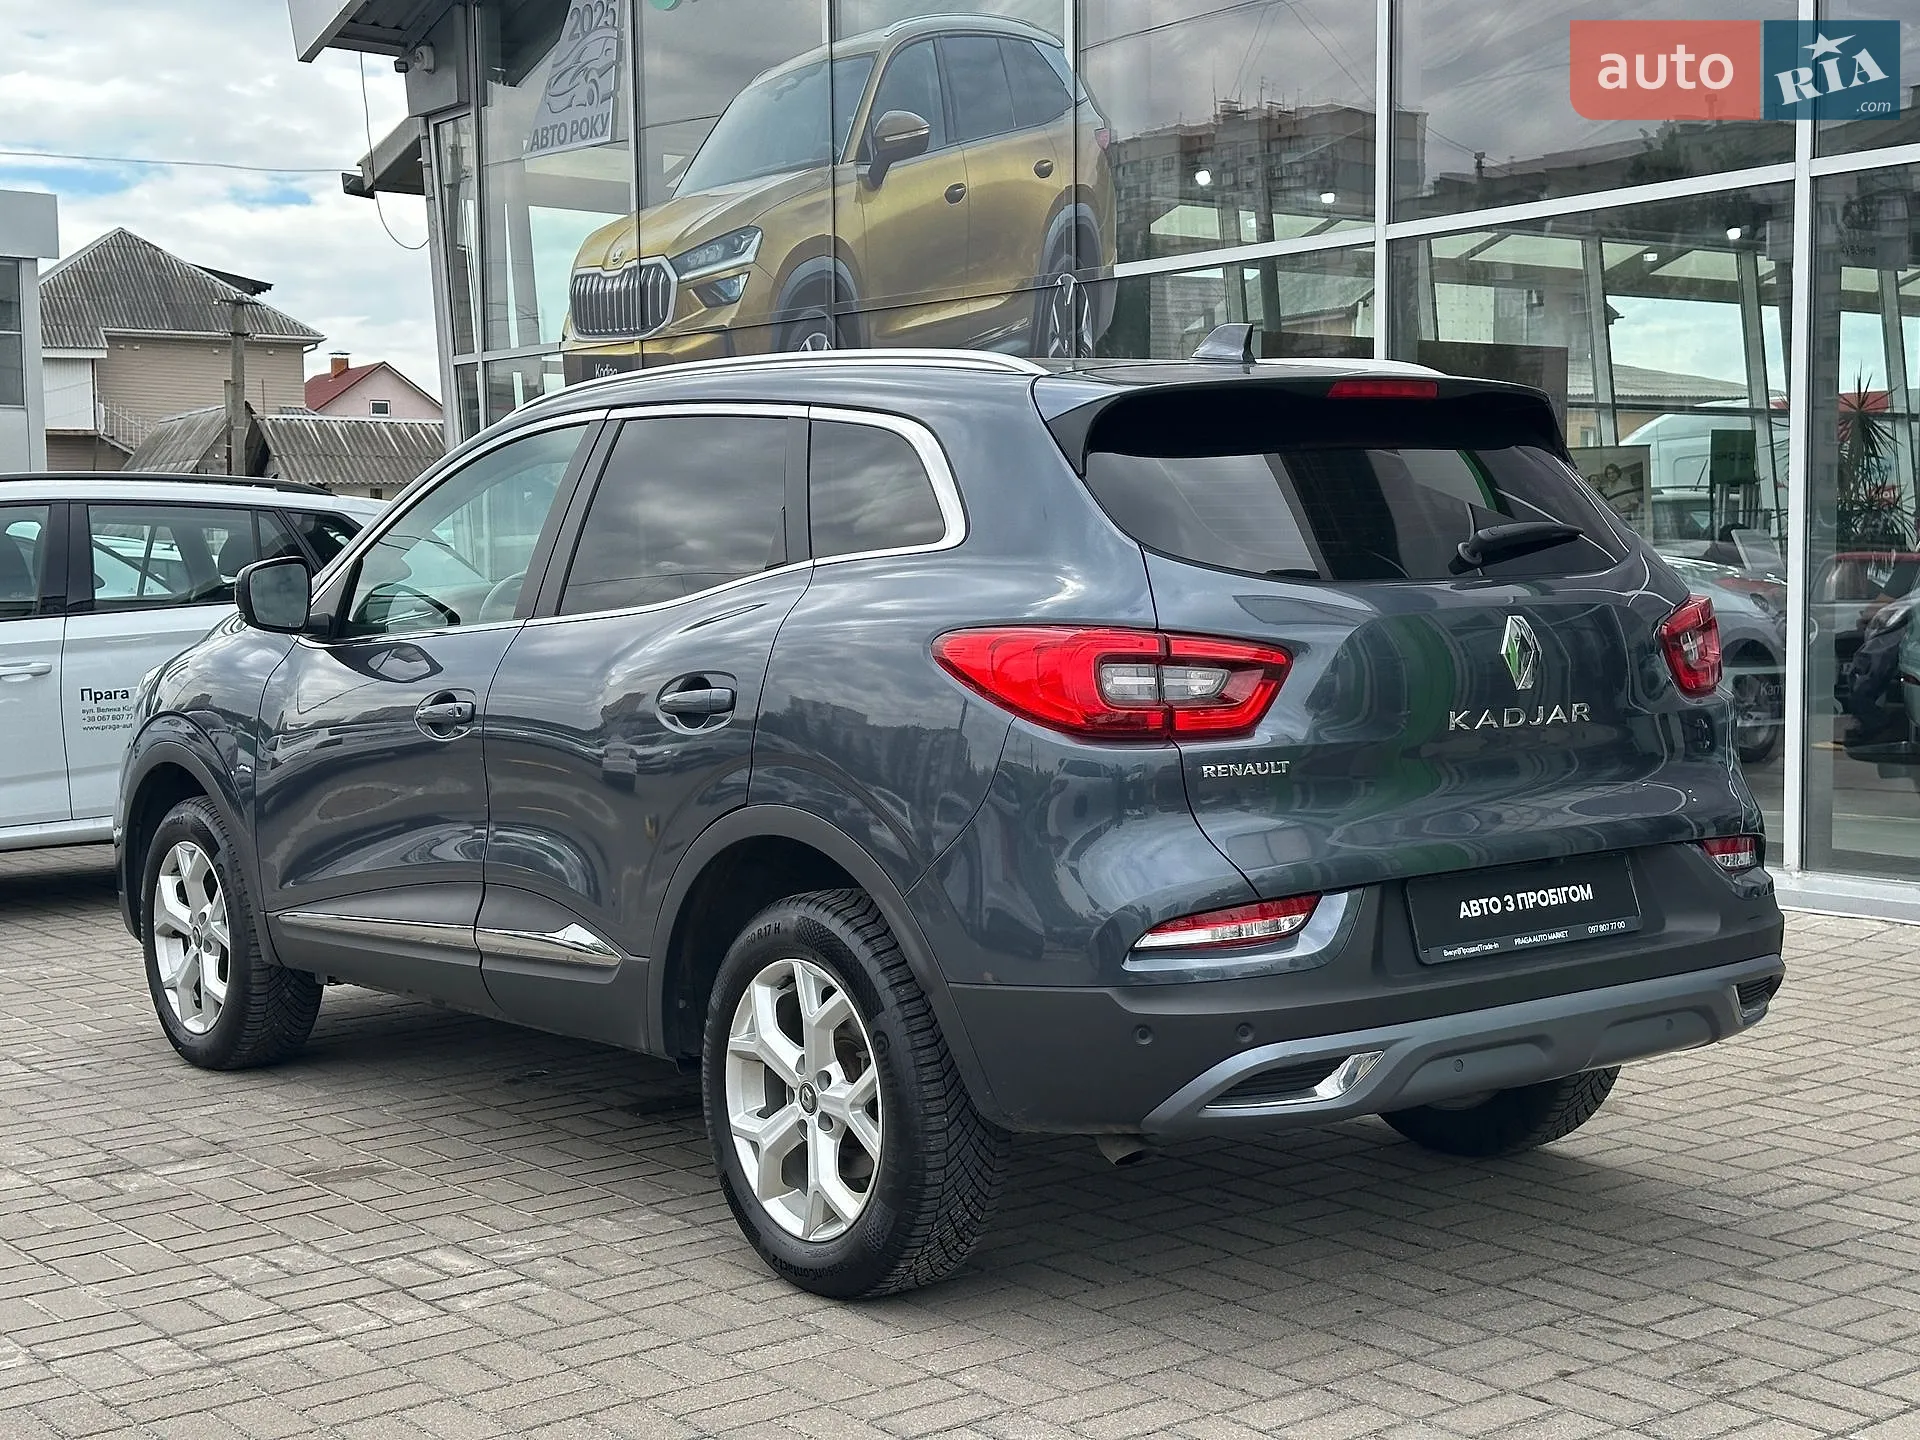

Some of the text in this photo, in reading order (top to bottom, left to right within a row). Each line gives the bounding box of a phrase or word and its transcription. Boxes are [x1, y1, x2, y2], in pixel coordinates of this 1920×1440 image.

[568, 0, 617, 41] 2025
[531, 111, 610, 151] АВТО РОКУ
[80, 688, 129, 704] Прага
[1449, 702, 1591, 731] KADJAR
[1201, 760, 1290, 778] RENAULT
[1460, 896, 1501, 918] АВТО
[1516, 883, 1594, 910] ПРОБІГОМ
[1599, 923, 1609, 932] 807
[1610, 921, 1617, 930] 77
[1617, 920, 1626, 929] 00
[1514, 930, 1568, 946] PRAGA AUTO MARKET
